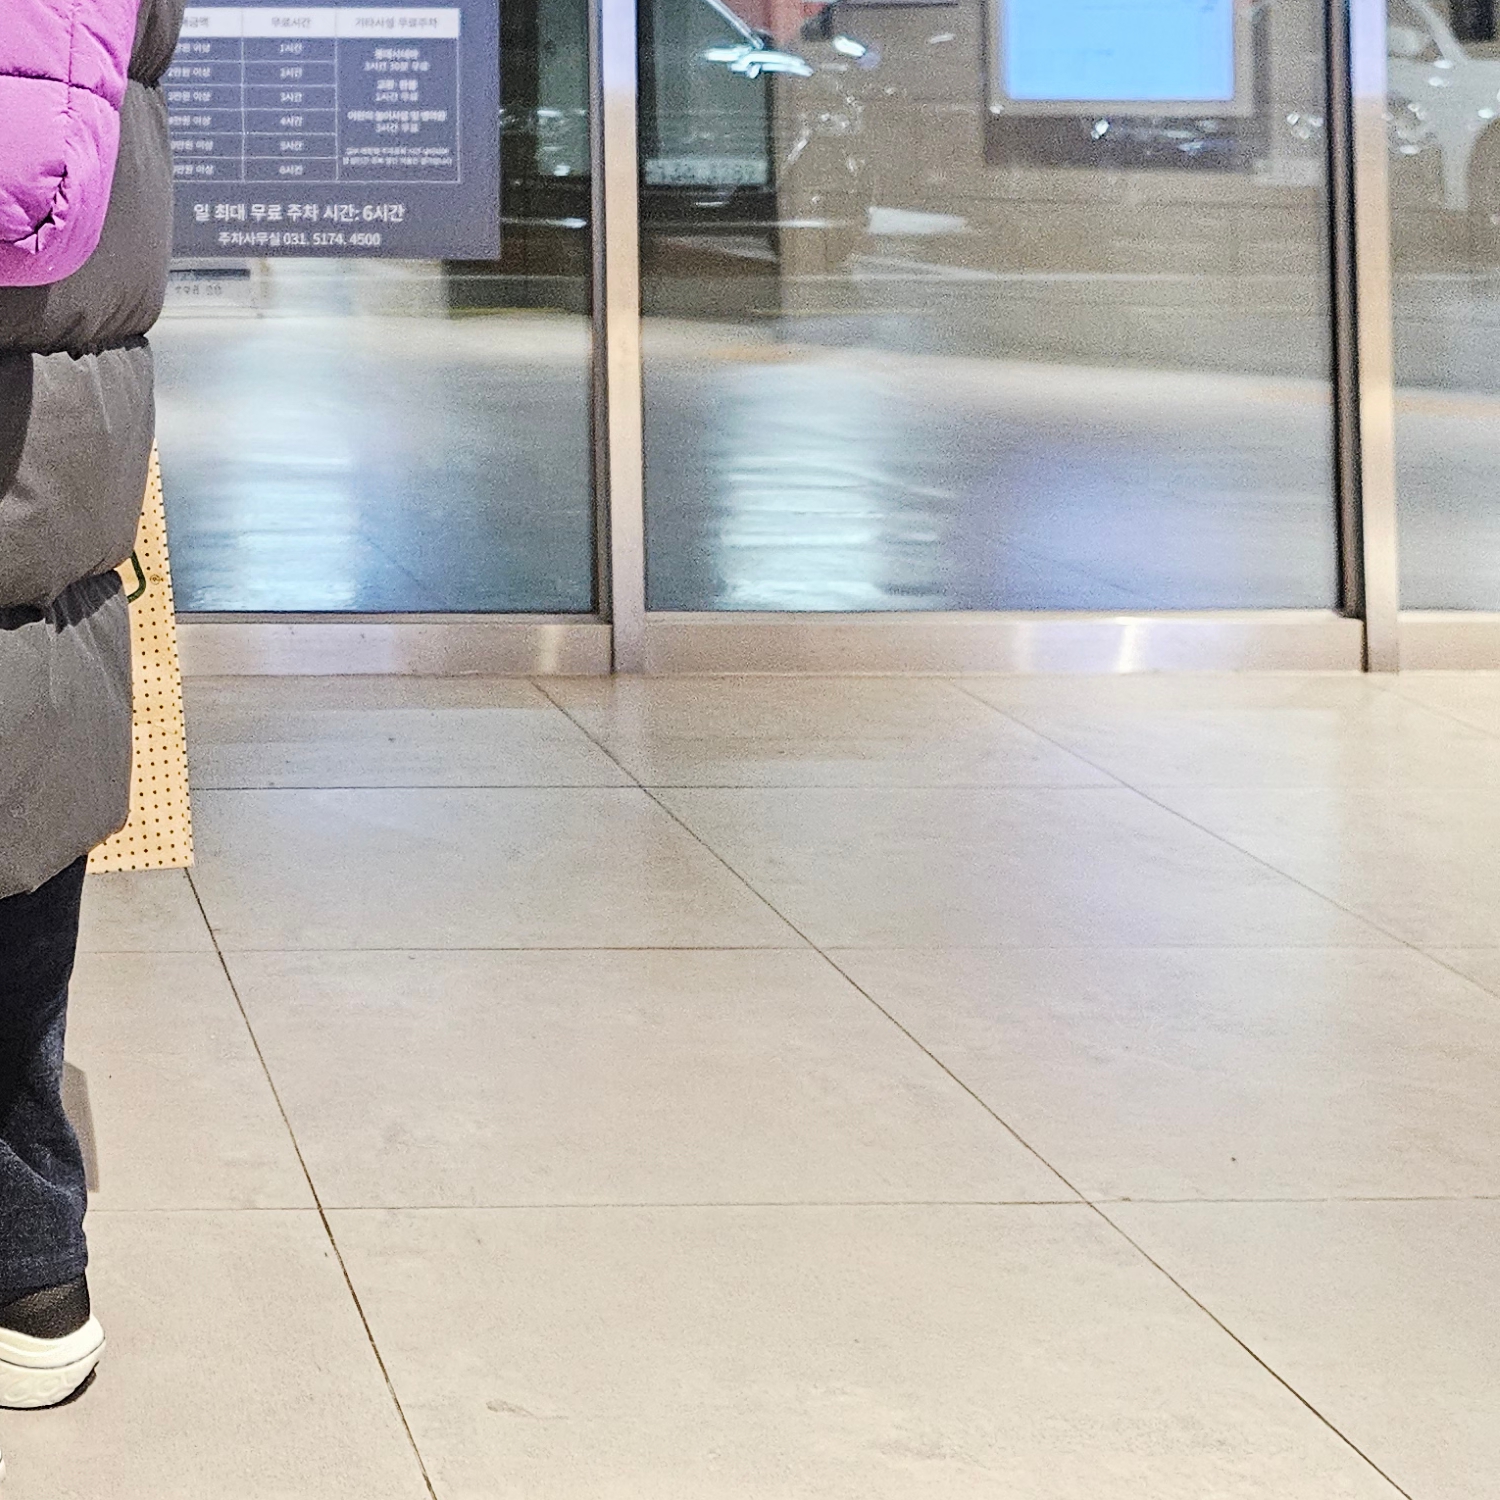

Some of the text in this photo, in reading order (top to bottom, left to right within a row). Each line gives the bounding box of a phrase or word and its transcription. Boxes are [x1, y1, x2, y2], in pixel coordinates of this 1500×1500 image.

[215, 204, 246, 222] 최대
[251, 204, 282, 222] 무료
[287, 204, 319, 222] 주차
[218, 232, 281, 247] 주차사무실
[350, 233, 381, 246] 4500
